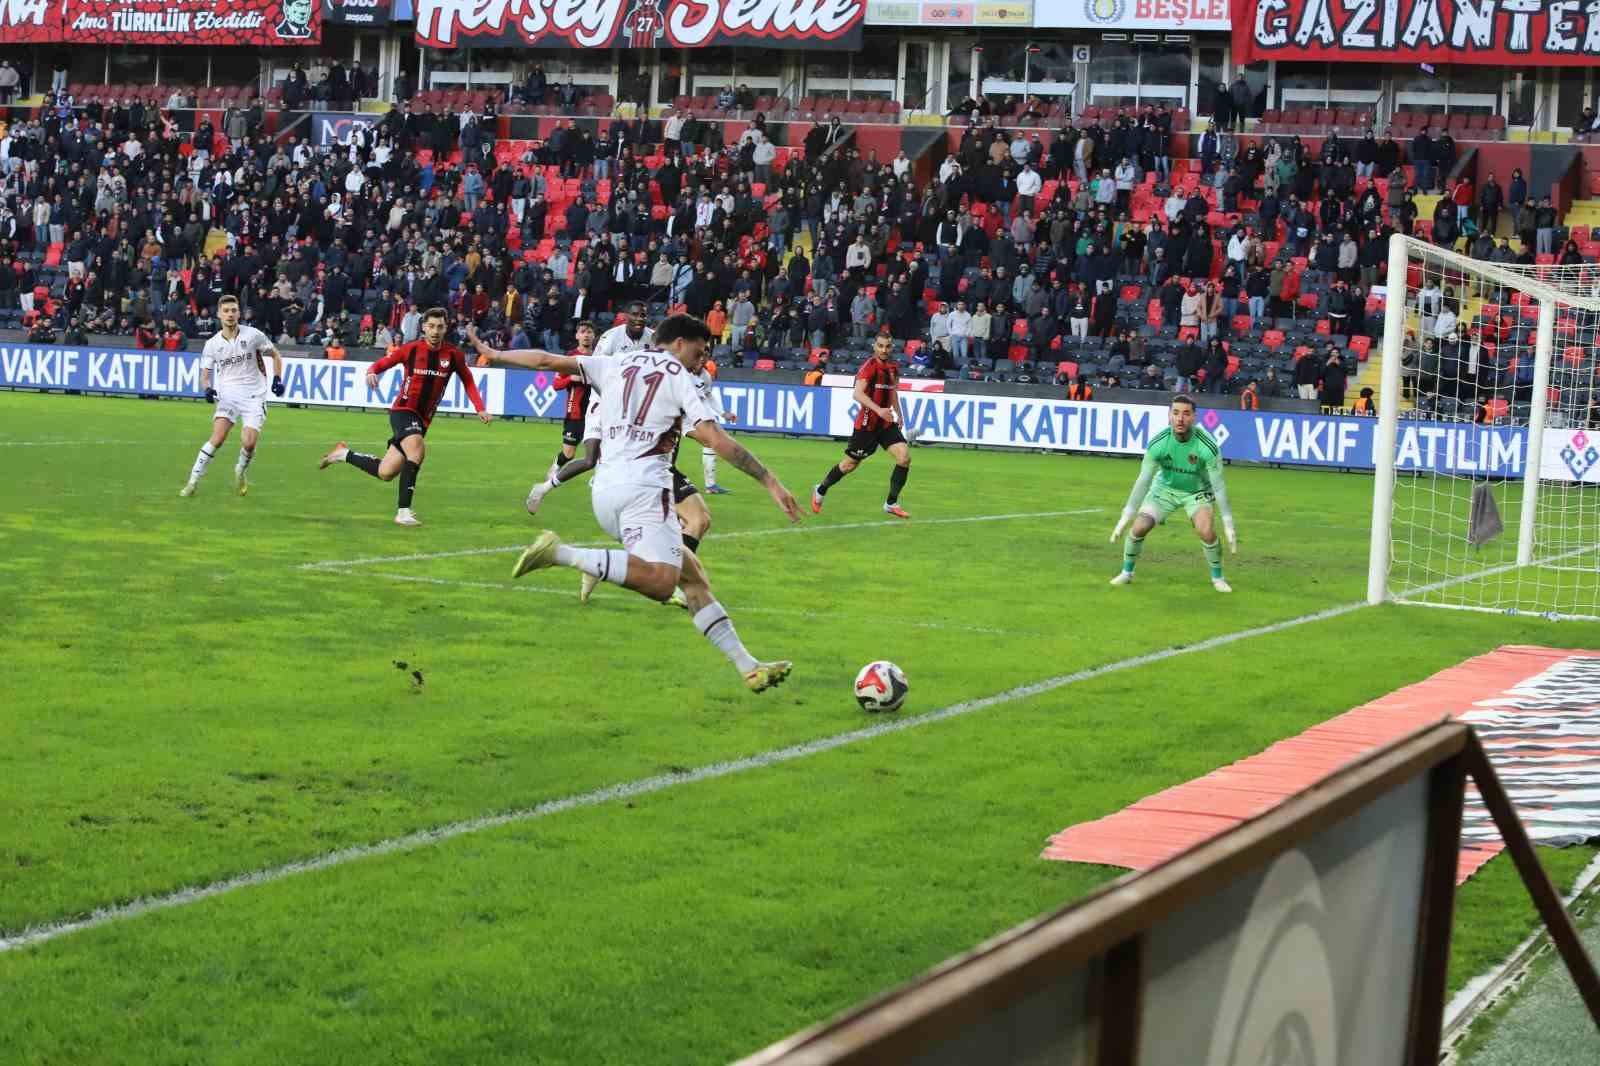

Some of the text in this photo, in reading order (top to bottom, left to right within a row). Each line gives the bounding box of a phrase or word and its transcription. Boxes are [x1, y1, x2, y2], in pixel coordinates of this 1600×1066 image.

[72, 8, 265, 32] Ama TÜRKLÜK Ebedidir
[637, 17, 652, 32] 27
[1076, 48, 1088, 60] G
[2, 348, 201, 393] VAKIF KATILIM
[366, 369, 488, 409] KAIM
[621, 365, 665, 427] 11
[900, 396, 997, 440] VAKIF
[1009, 403, 1151, 449] KATILIM
[1254, 417, 1361, 462] VAKIF
